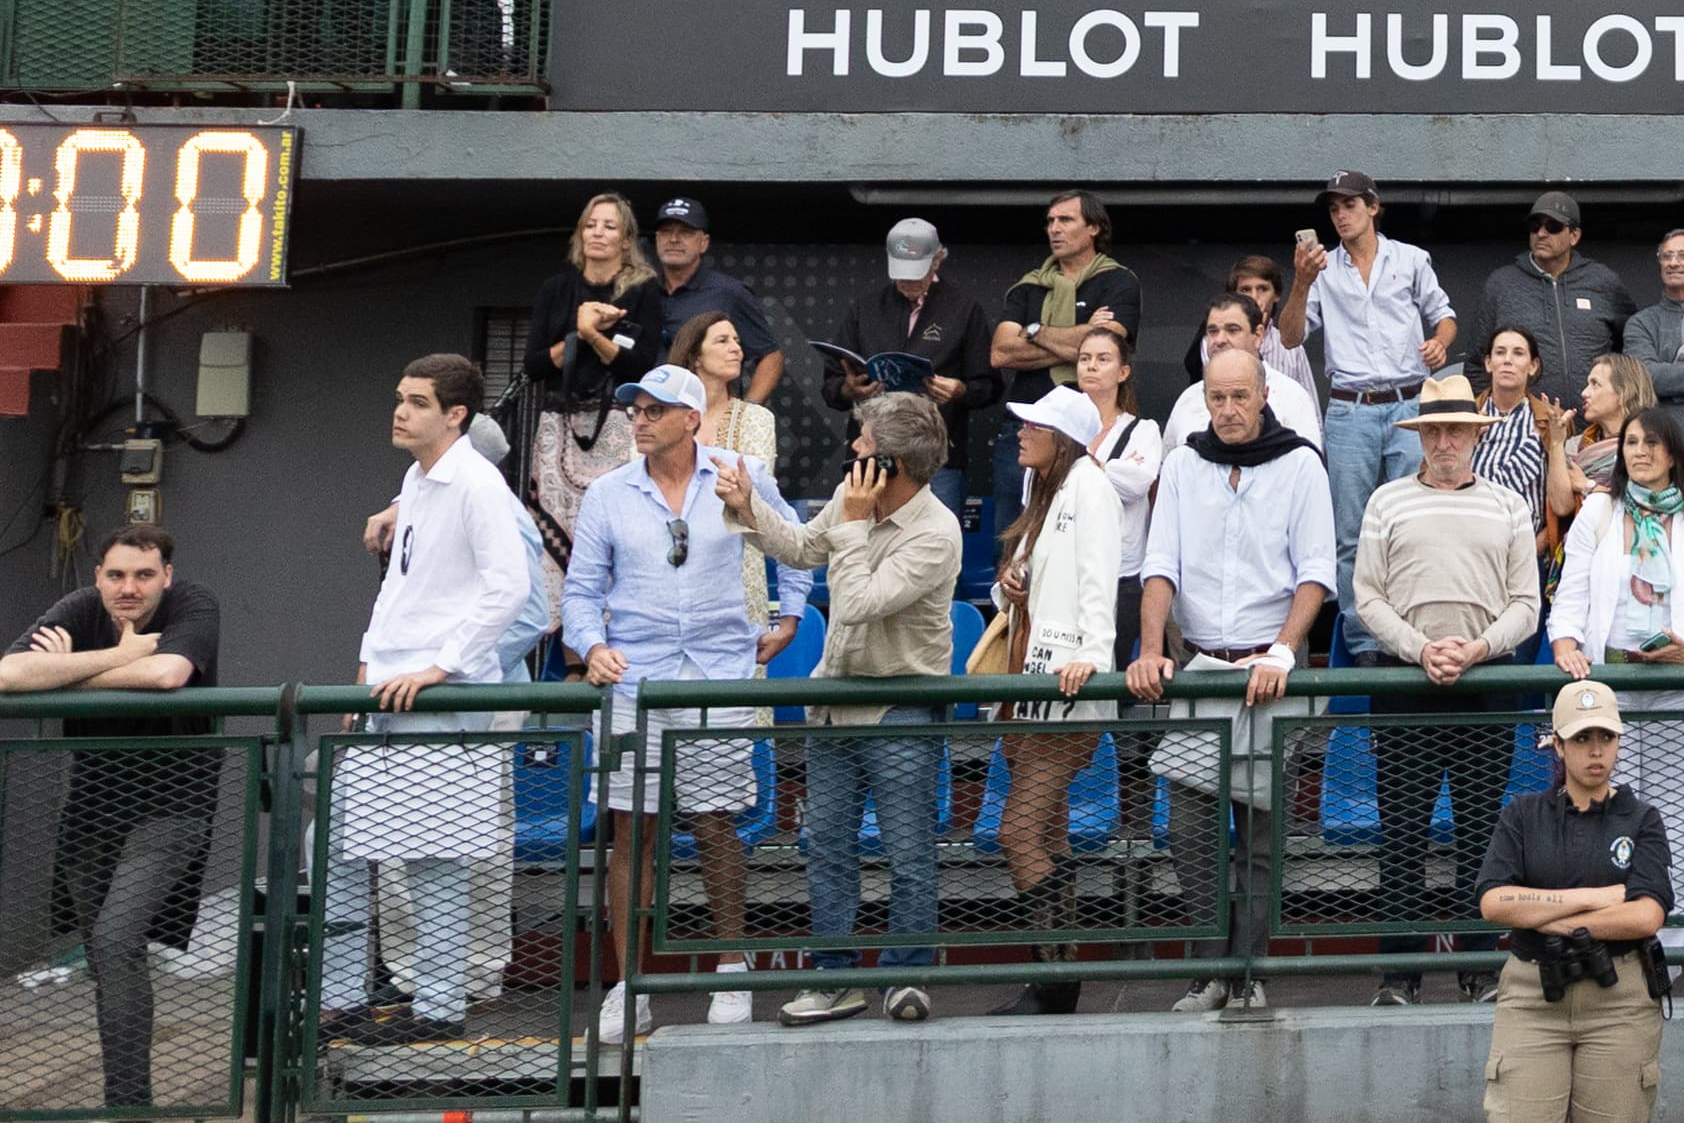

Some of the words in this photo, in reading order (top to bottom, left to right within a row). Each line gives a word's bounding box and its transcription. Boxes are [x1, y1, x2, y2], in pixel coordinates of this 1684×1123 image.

[788, 9, 1199, 79] HUBLOT
[0, 129, 269, 282] :00
[270, 130, 294, 281] www.takito.com.ar
[1032, 646, 1053, 662] CAN
